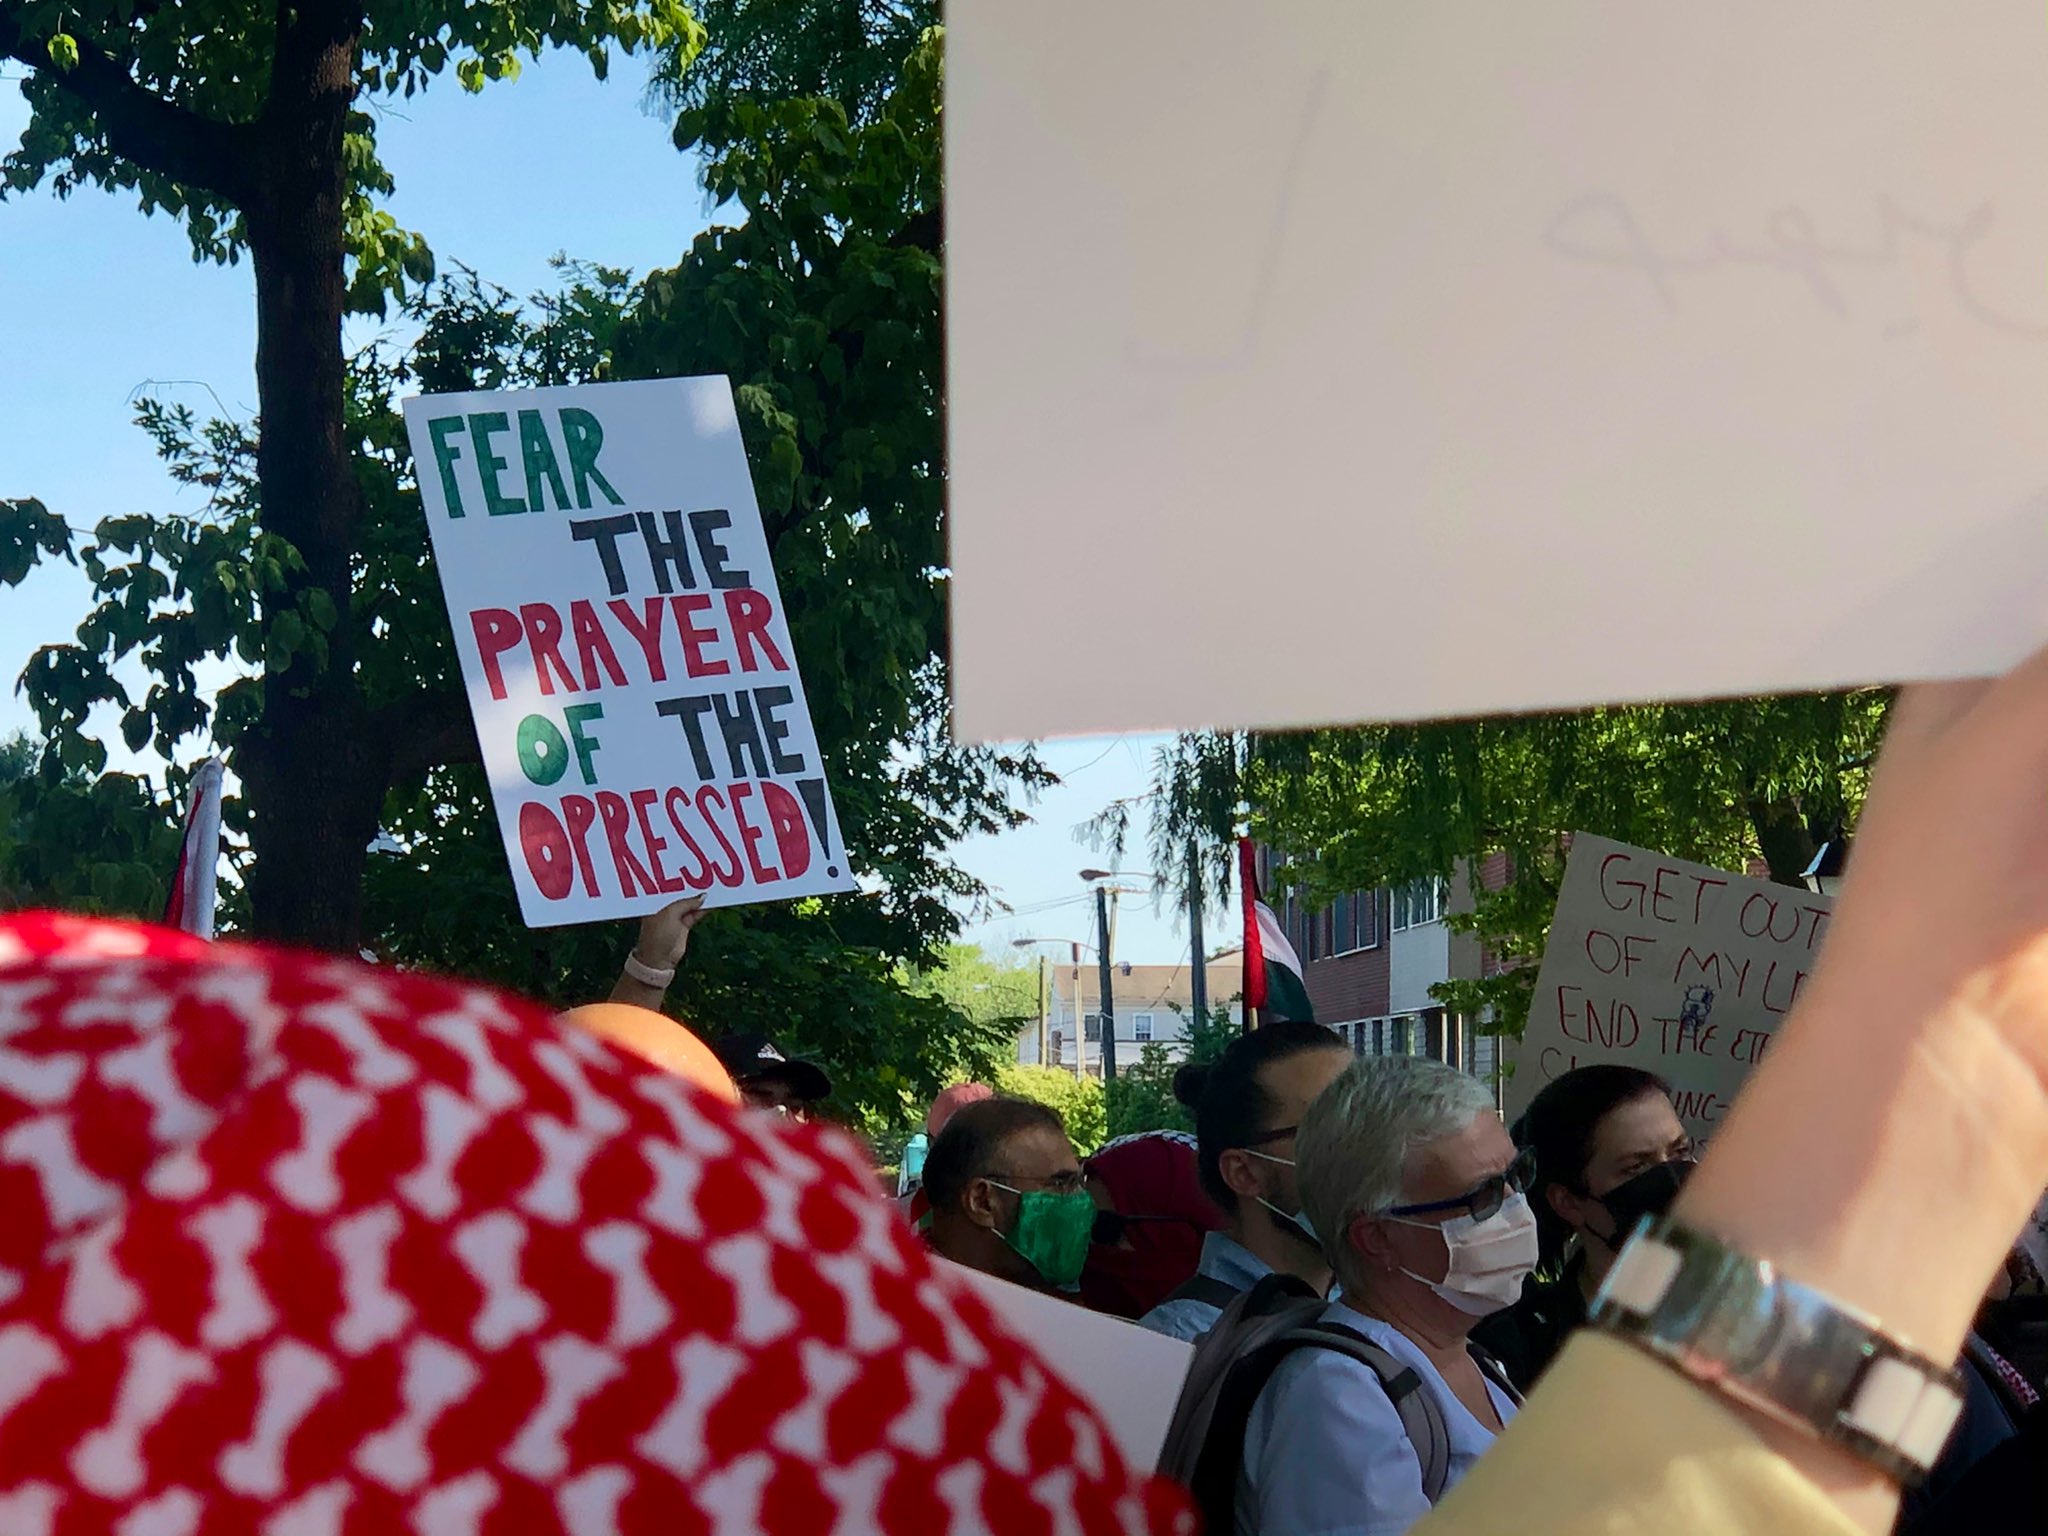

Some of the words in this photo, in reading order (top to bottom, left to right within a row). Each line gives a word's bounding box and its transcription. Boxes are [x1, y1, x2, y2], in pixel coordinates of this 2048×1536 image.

[427, 407, 625, 519] FEAR
[569, 510, 752, 595] THE
[470, 588, 790, 700] PRAYER
[516, 703, 604, 787] OF
[656, 685, 805, 781] THE
[518, 779, 840, 901] OPRESSED!
[1600, 853, 1728, 924] GET
[1739, 893, 1831, 949] OUT
[1586, 930, 1657, 978] OF
[1674, 946, 1750, 997] MY
[1558, 985, 1640, 1049] END
[1652, 1017, 1720, 1056] THE
